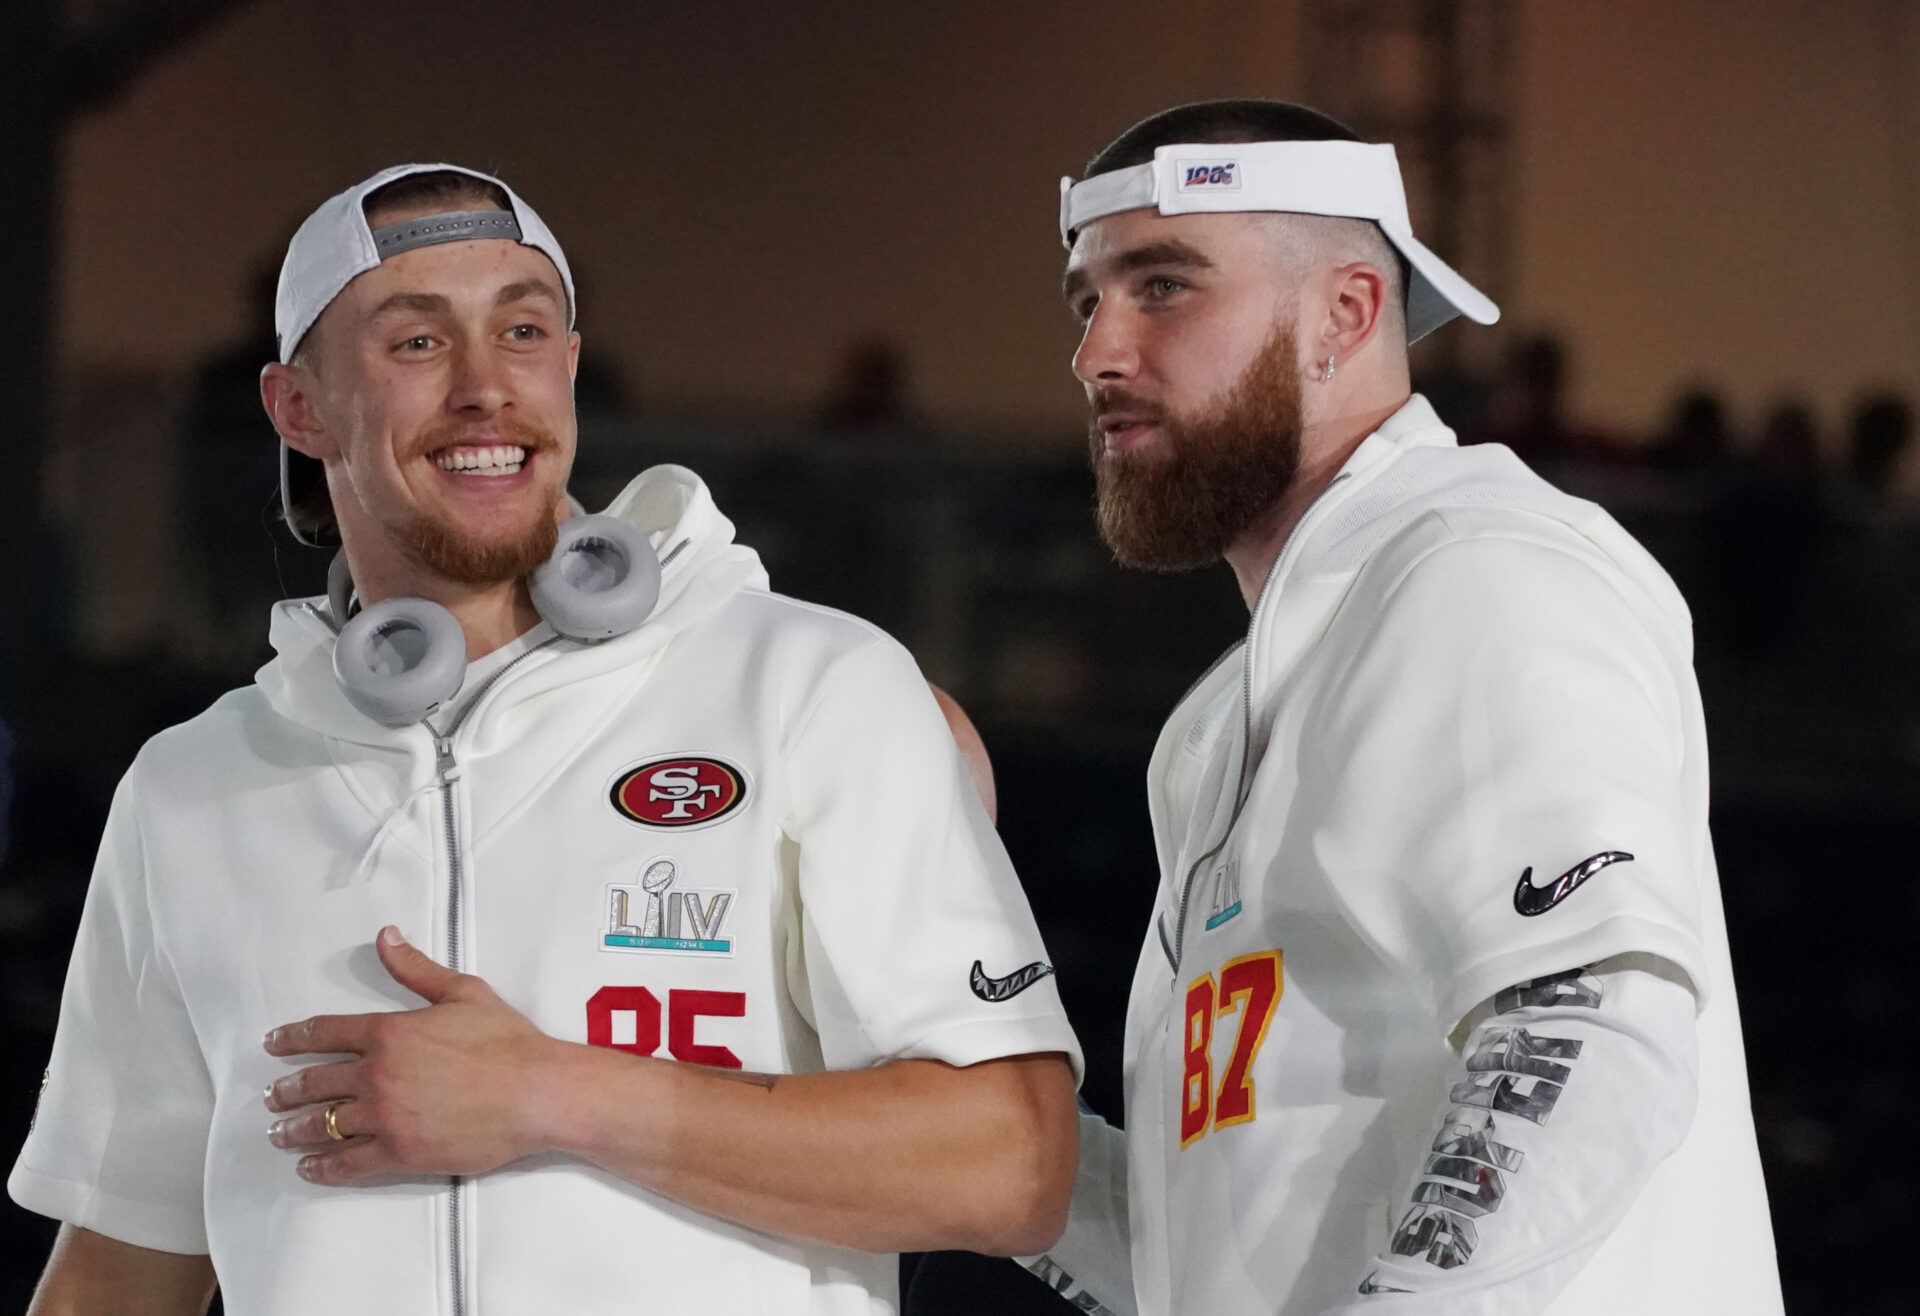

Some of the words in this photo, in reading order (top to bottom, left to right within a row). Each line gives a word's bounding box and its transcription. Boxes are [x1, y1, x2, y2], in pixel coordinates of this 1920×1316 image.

[1184, 166, 1225, 187] 100
[649, 766, 720, 818] SF
[629, 937, 667, 947] SUP
[1181, 948, 1285, 1152] 87
[1391, 1026, 1584, 1270] SUPER
